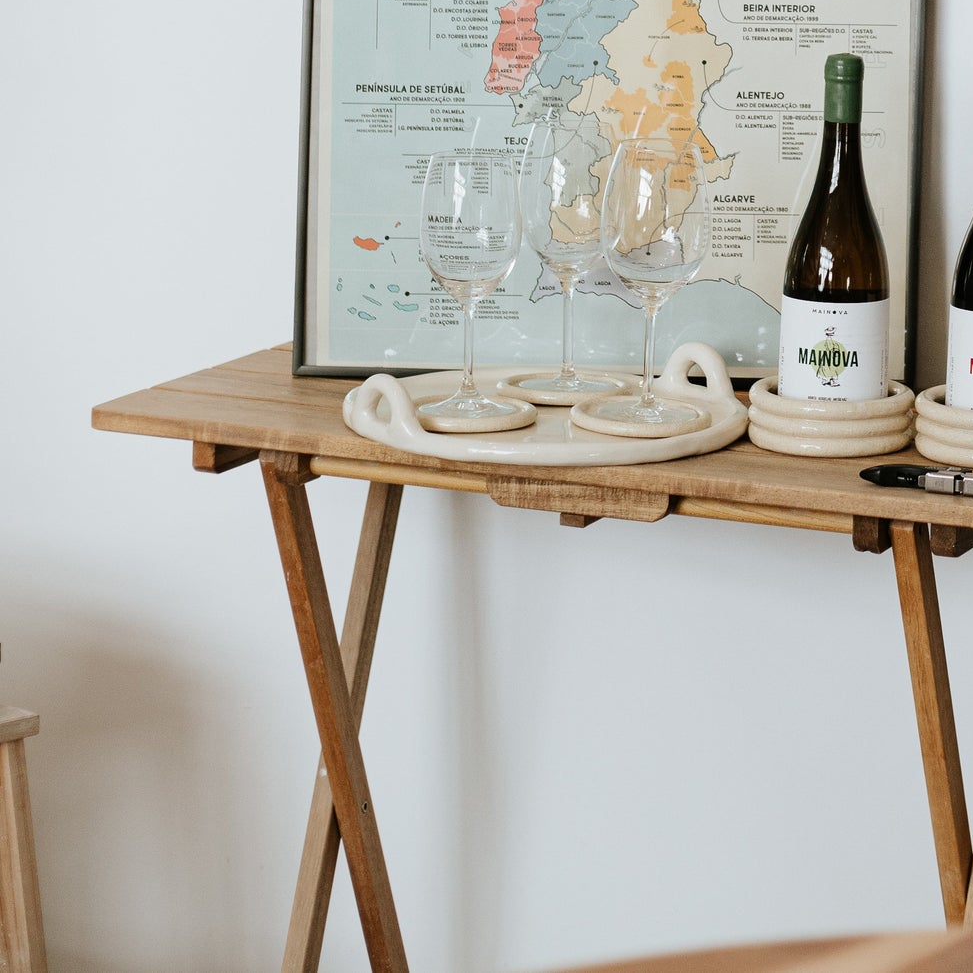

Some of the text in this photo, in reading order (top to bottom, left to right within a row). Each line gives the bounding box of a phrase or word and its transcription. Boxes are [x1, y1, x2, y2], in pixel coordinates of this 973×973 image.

[743, 4, 816, 13] BEIRA INTERIOR
[356, 82, 466, 94] PENÍNSULA DE SETÚBAL
[736, 92, 785, 100] ALENTEJO
[504, 137, 529, 145] TEJO
[713, 195, 756, 203] ALGARVE
[428, 215, 462, 224] MADEIA
[799, 347, 858, 367] MAINOVA
